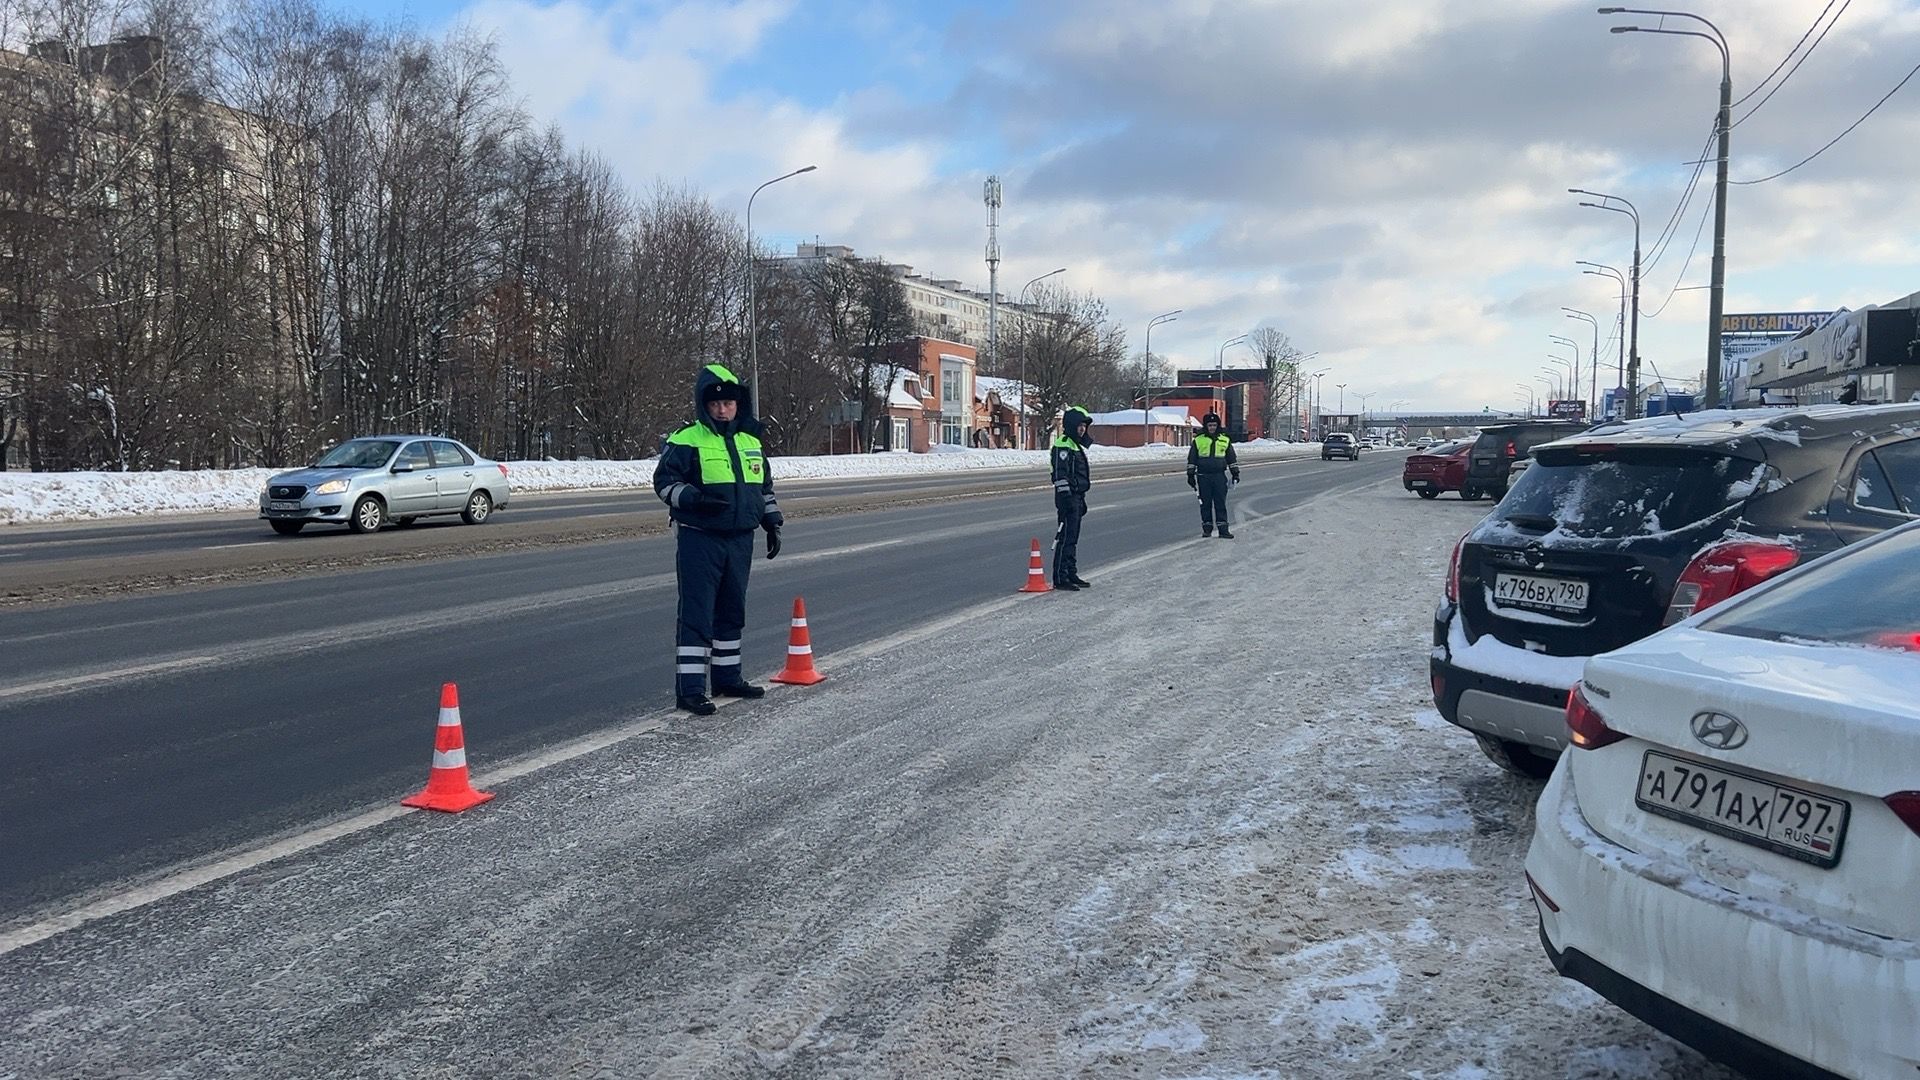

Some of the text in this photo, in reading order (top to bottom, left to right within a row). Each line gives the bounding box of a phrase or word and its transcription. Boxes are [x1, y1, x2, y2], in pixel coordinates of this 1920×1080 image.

[1500, 578, 1583, 603] К796ВХ 790
[1650, 766, 1831, 834] А791АХ 797
[1784, 828, 1810, 845] RUS
